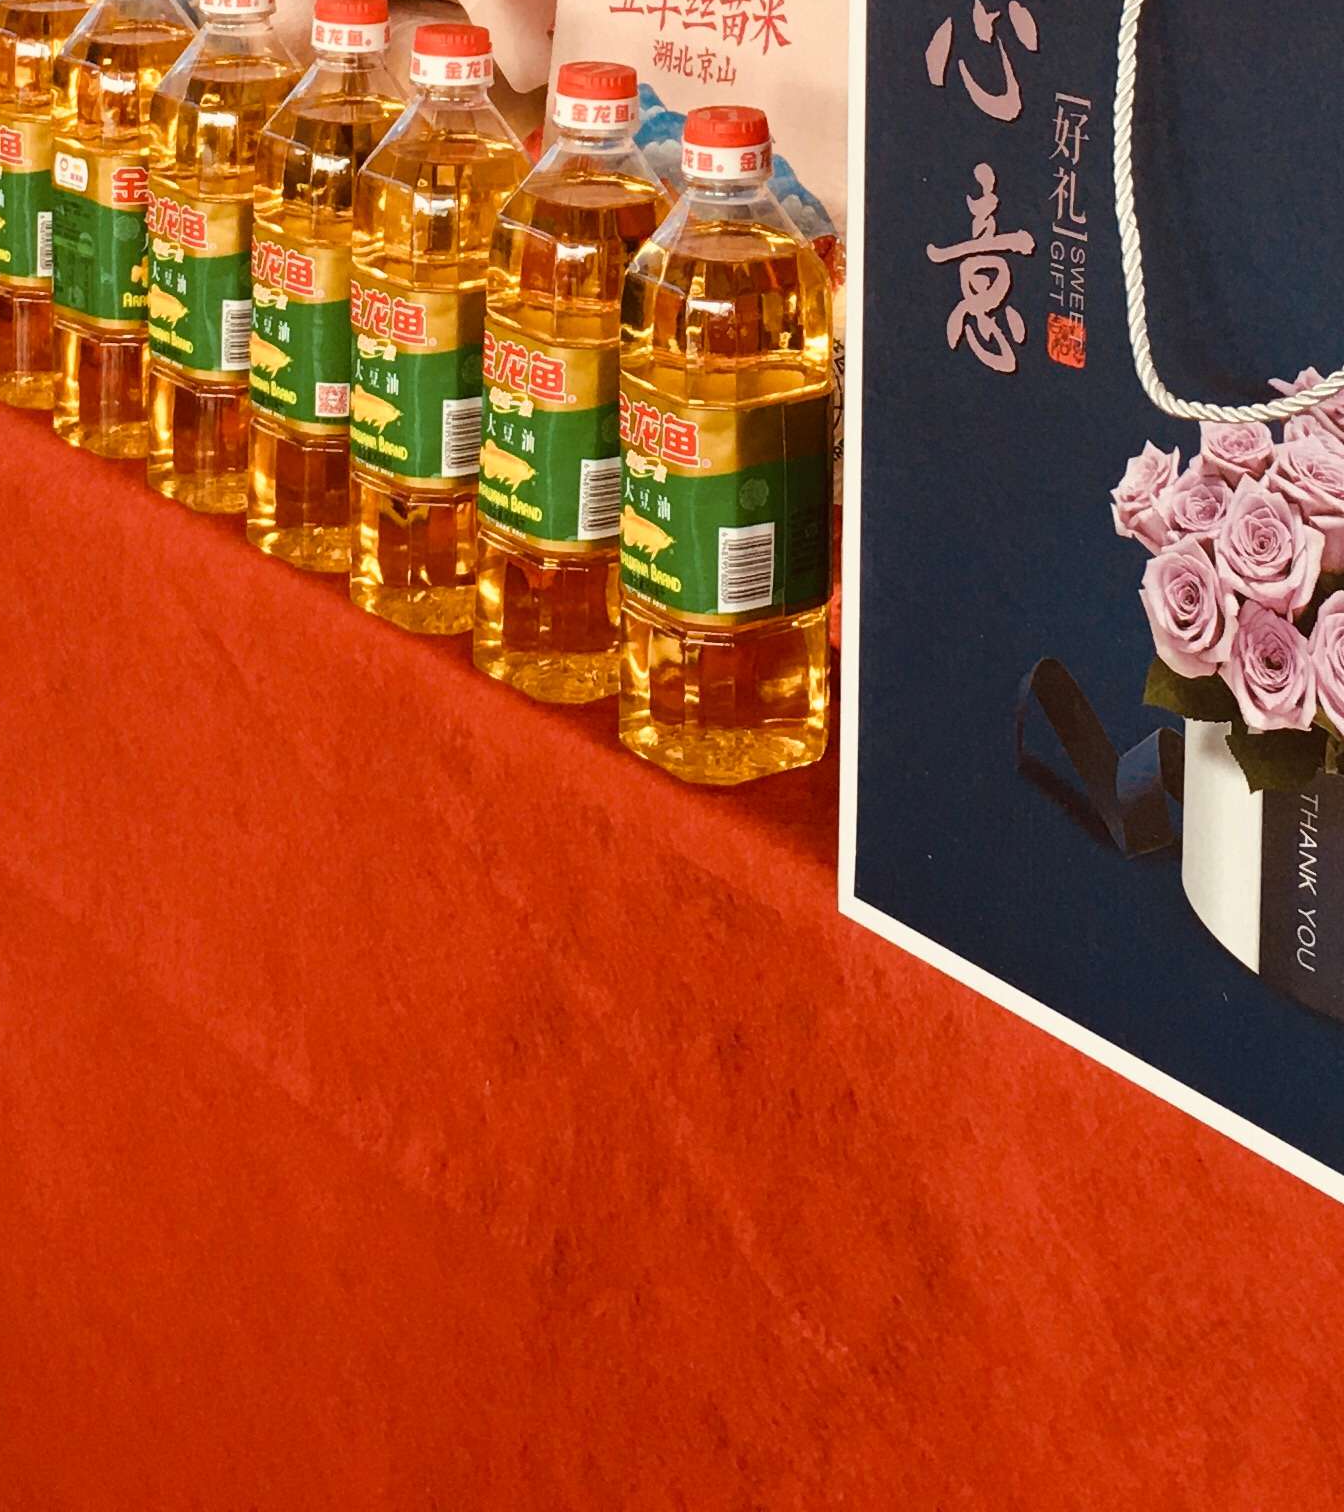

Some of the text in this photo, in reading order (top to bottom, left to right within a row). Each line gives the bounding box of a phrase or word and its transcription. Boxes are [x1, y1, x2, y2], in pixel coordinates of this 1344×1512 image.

[652, 39, 737, 86] 湖北京山
[571, 103, 630, 124] 金龙鱼
[925, 0, 1039, 373] 心意
[1049, 241, 1066, 307] GIFT
[623, 477, 671, 522] 大豆油
[1297, 793, 1319, 973] THANK YOU
